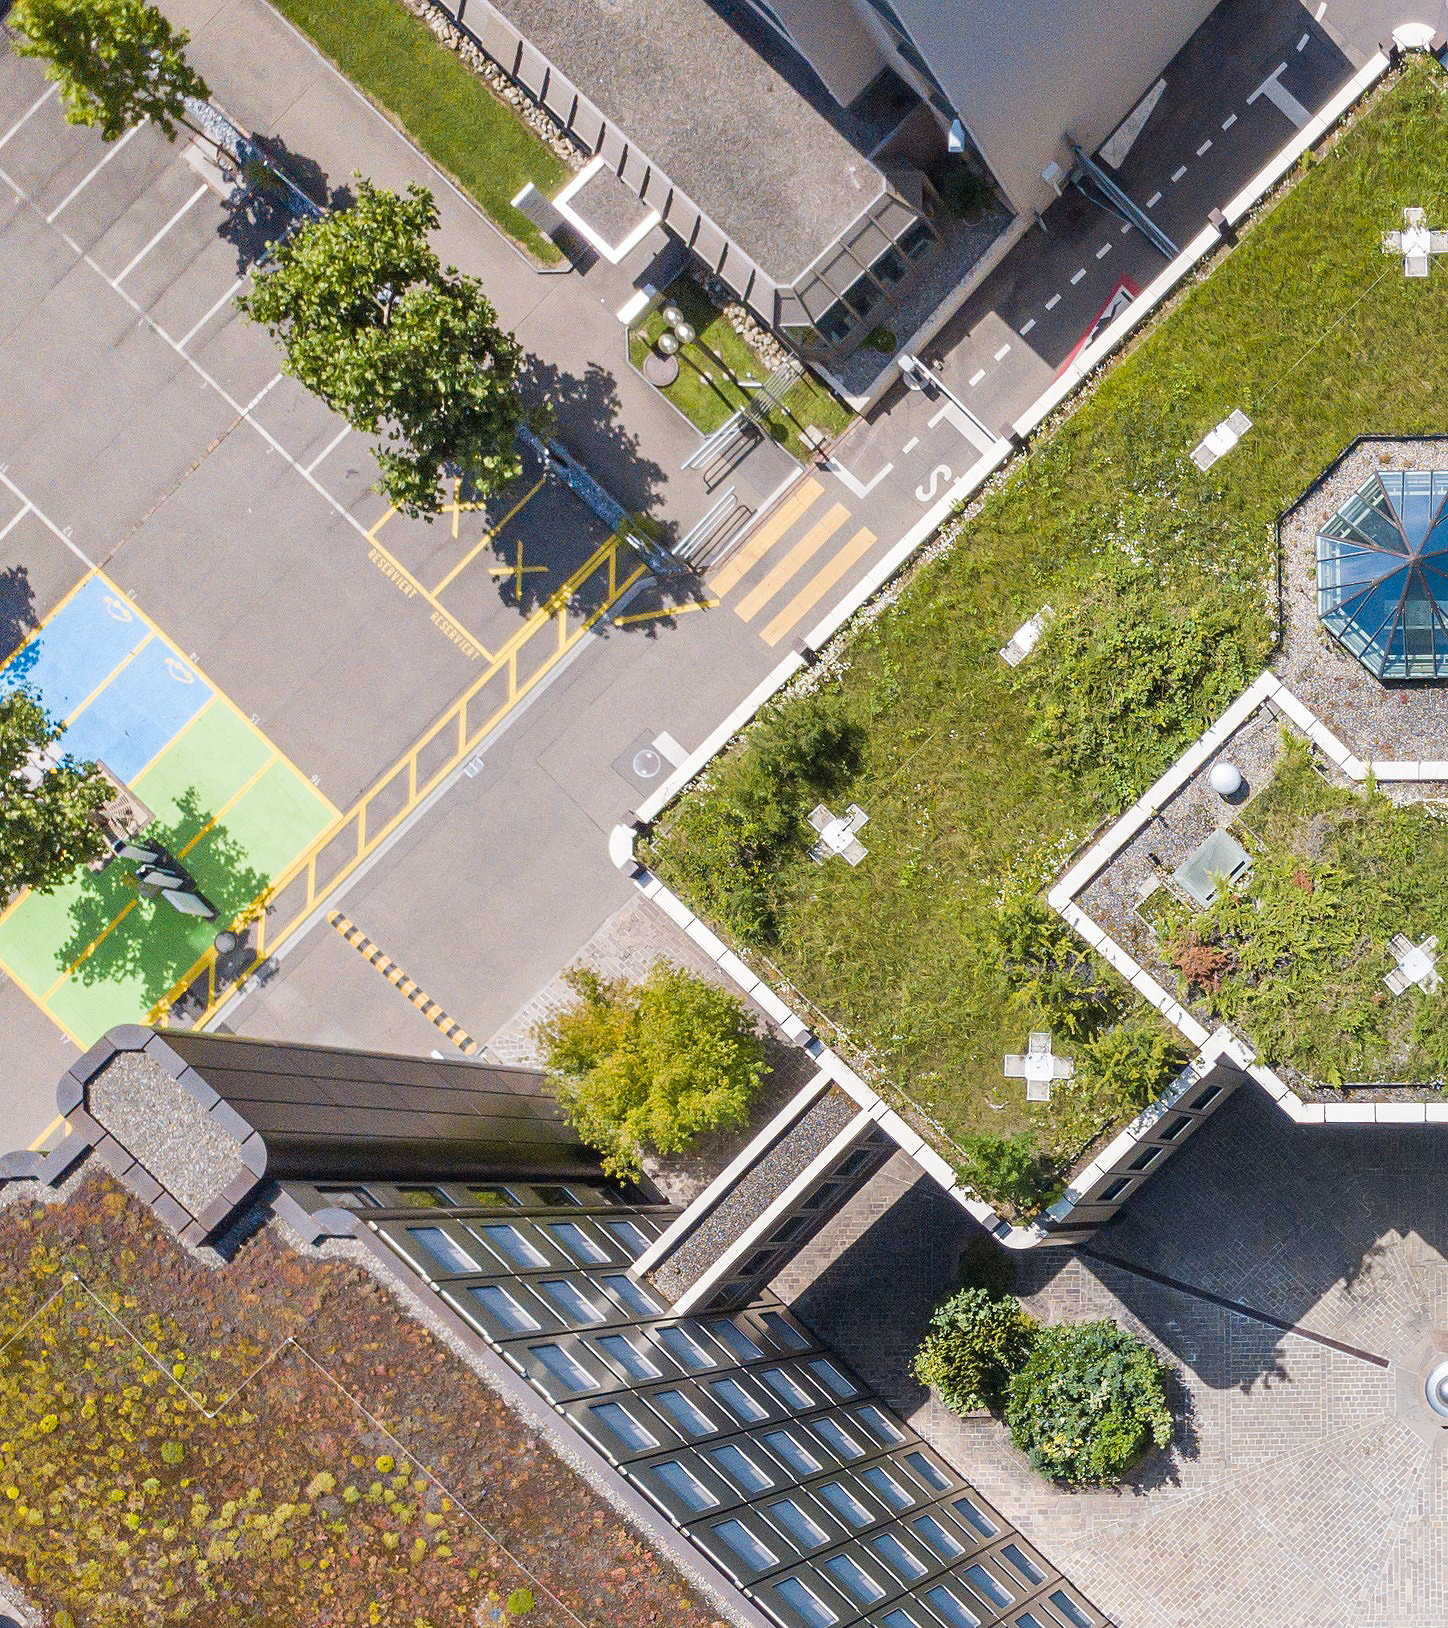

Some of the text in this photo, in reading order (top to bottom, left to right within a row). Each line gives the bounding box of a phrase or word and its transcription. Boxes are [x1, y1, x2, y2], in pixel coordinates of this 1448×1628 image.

[915, 464, 953, 502] S
[367, 549, 418, 600] RESERVIERT
[430, 611, 481, 662] RESERVIERT
